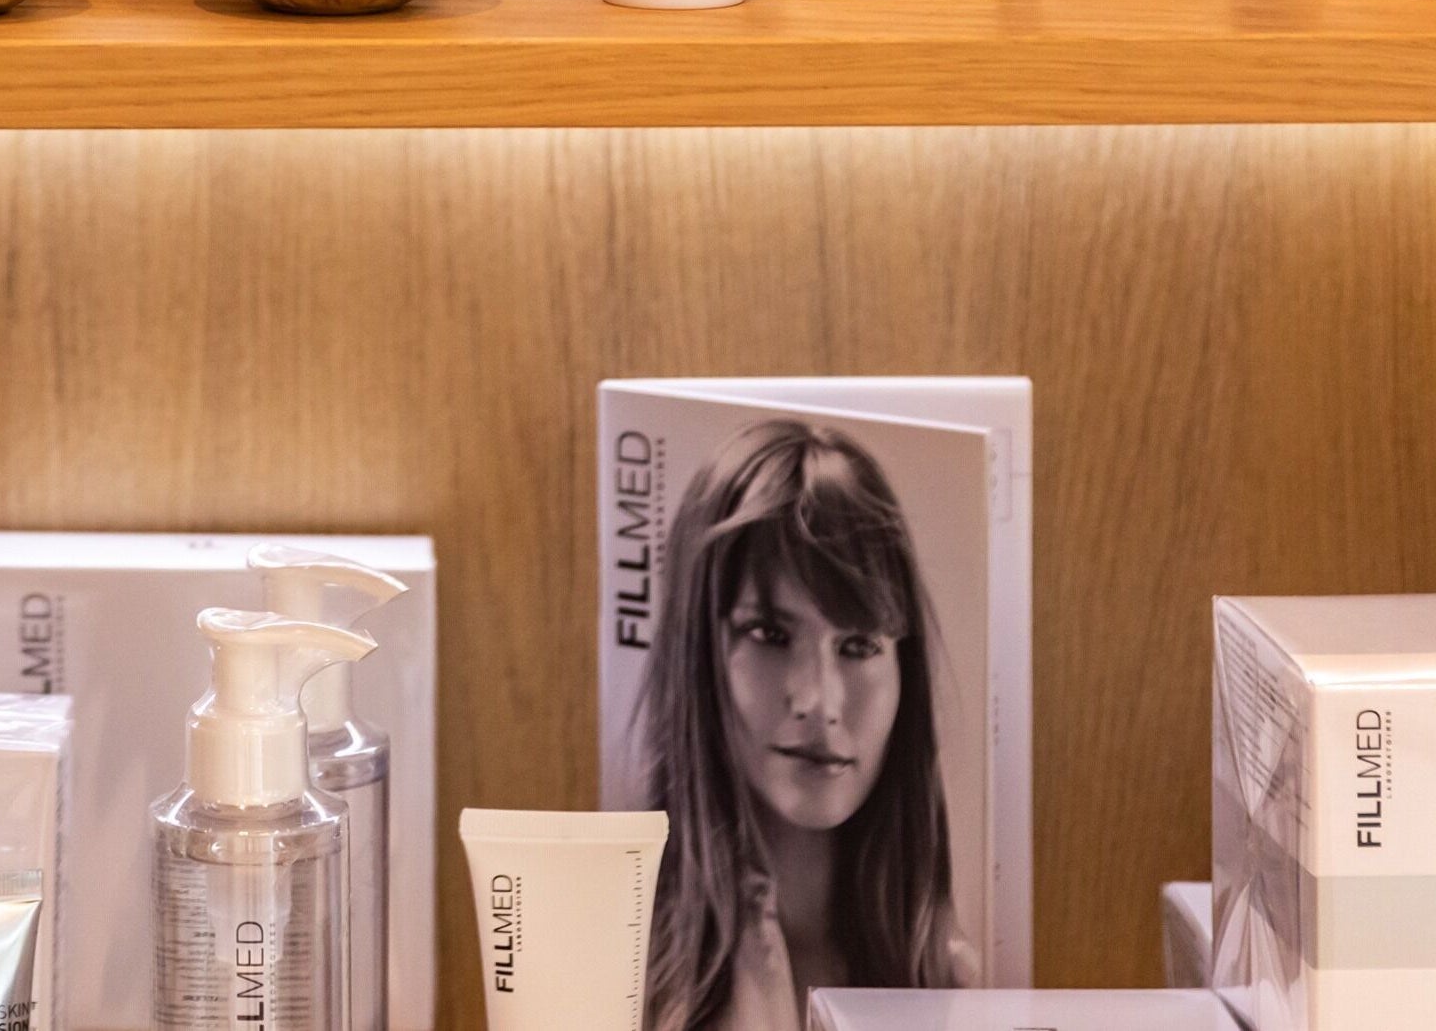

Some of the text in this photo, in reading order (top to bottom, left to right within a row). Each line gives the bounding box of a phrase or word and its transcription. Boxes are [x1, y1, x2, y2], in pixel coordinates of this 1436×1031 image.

[616, 431, 651, 649] FILLMED
[1357, 709, 1382, 848] FILLMED
[492, 874, 514, 993] FILLMED
